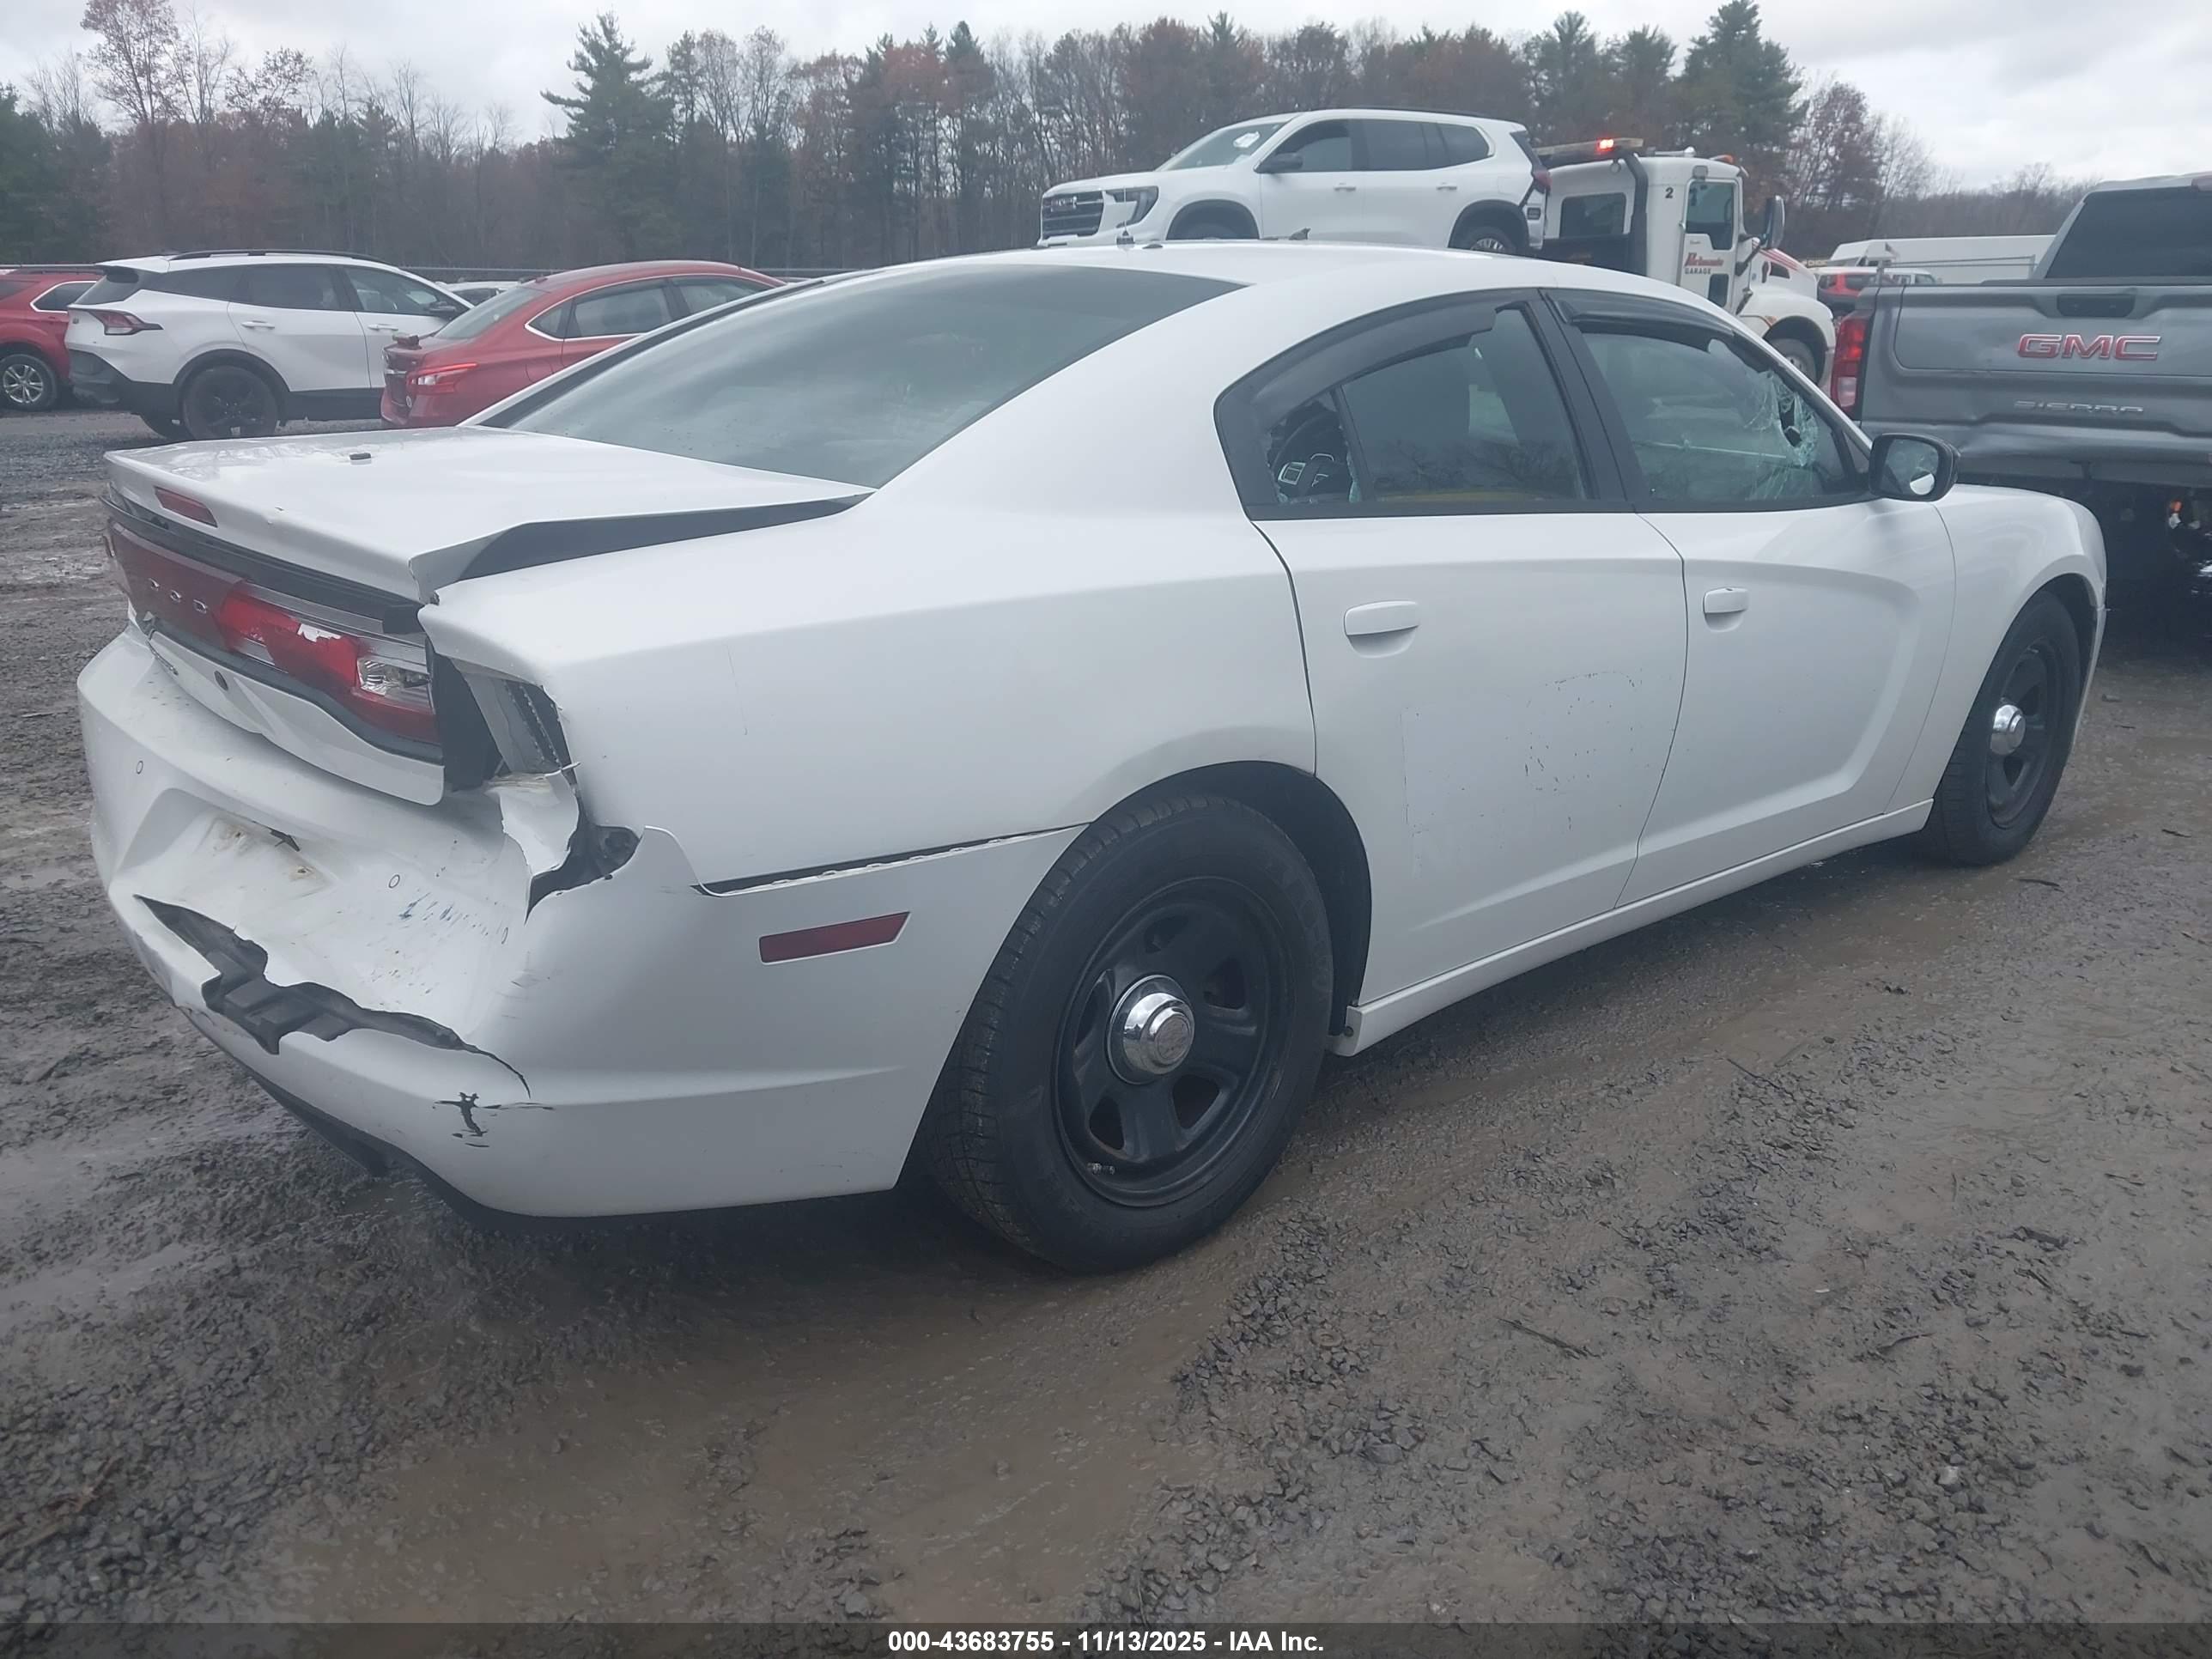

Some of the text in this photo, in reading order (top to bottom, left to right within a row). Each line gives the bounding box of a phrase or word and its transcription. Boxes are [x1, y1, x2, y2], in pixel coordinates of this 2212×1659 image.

[1665, 186, 1674, 198] 2
[2018, 333, 2161, 361] GMC
[2014, 400, 2144, 414] SIERRA
